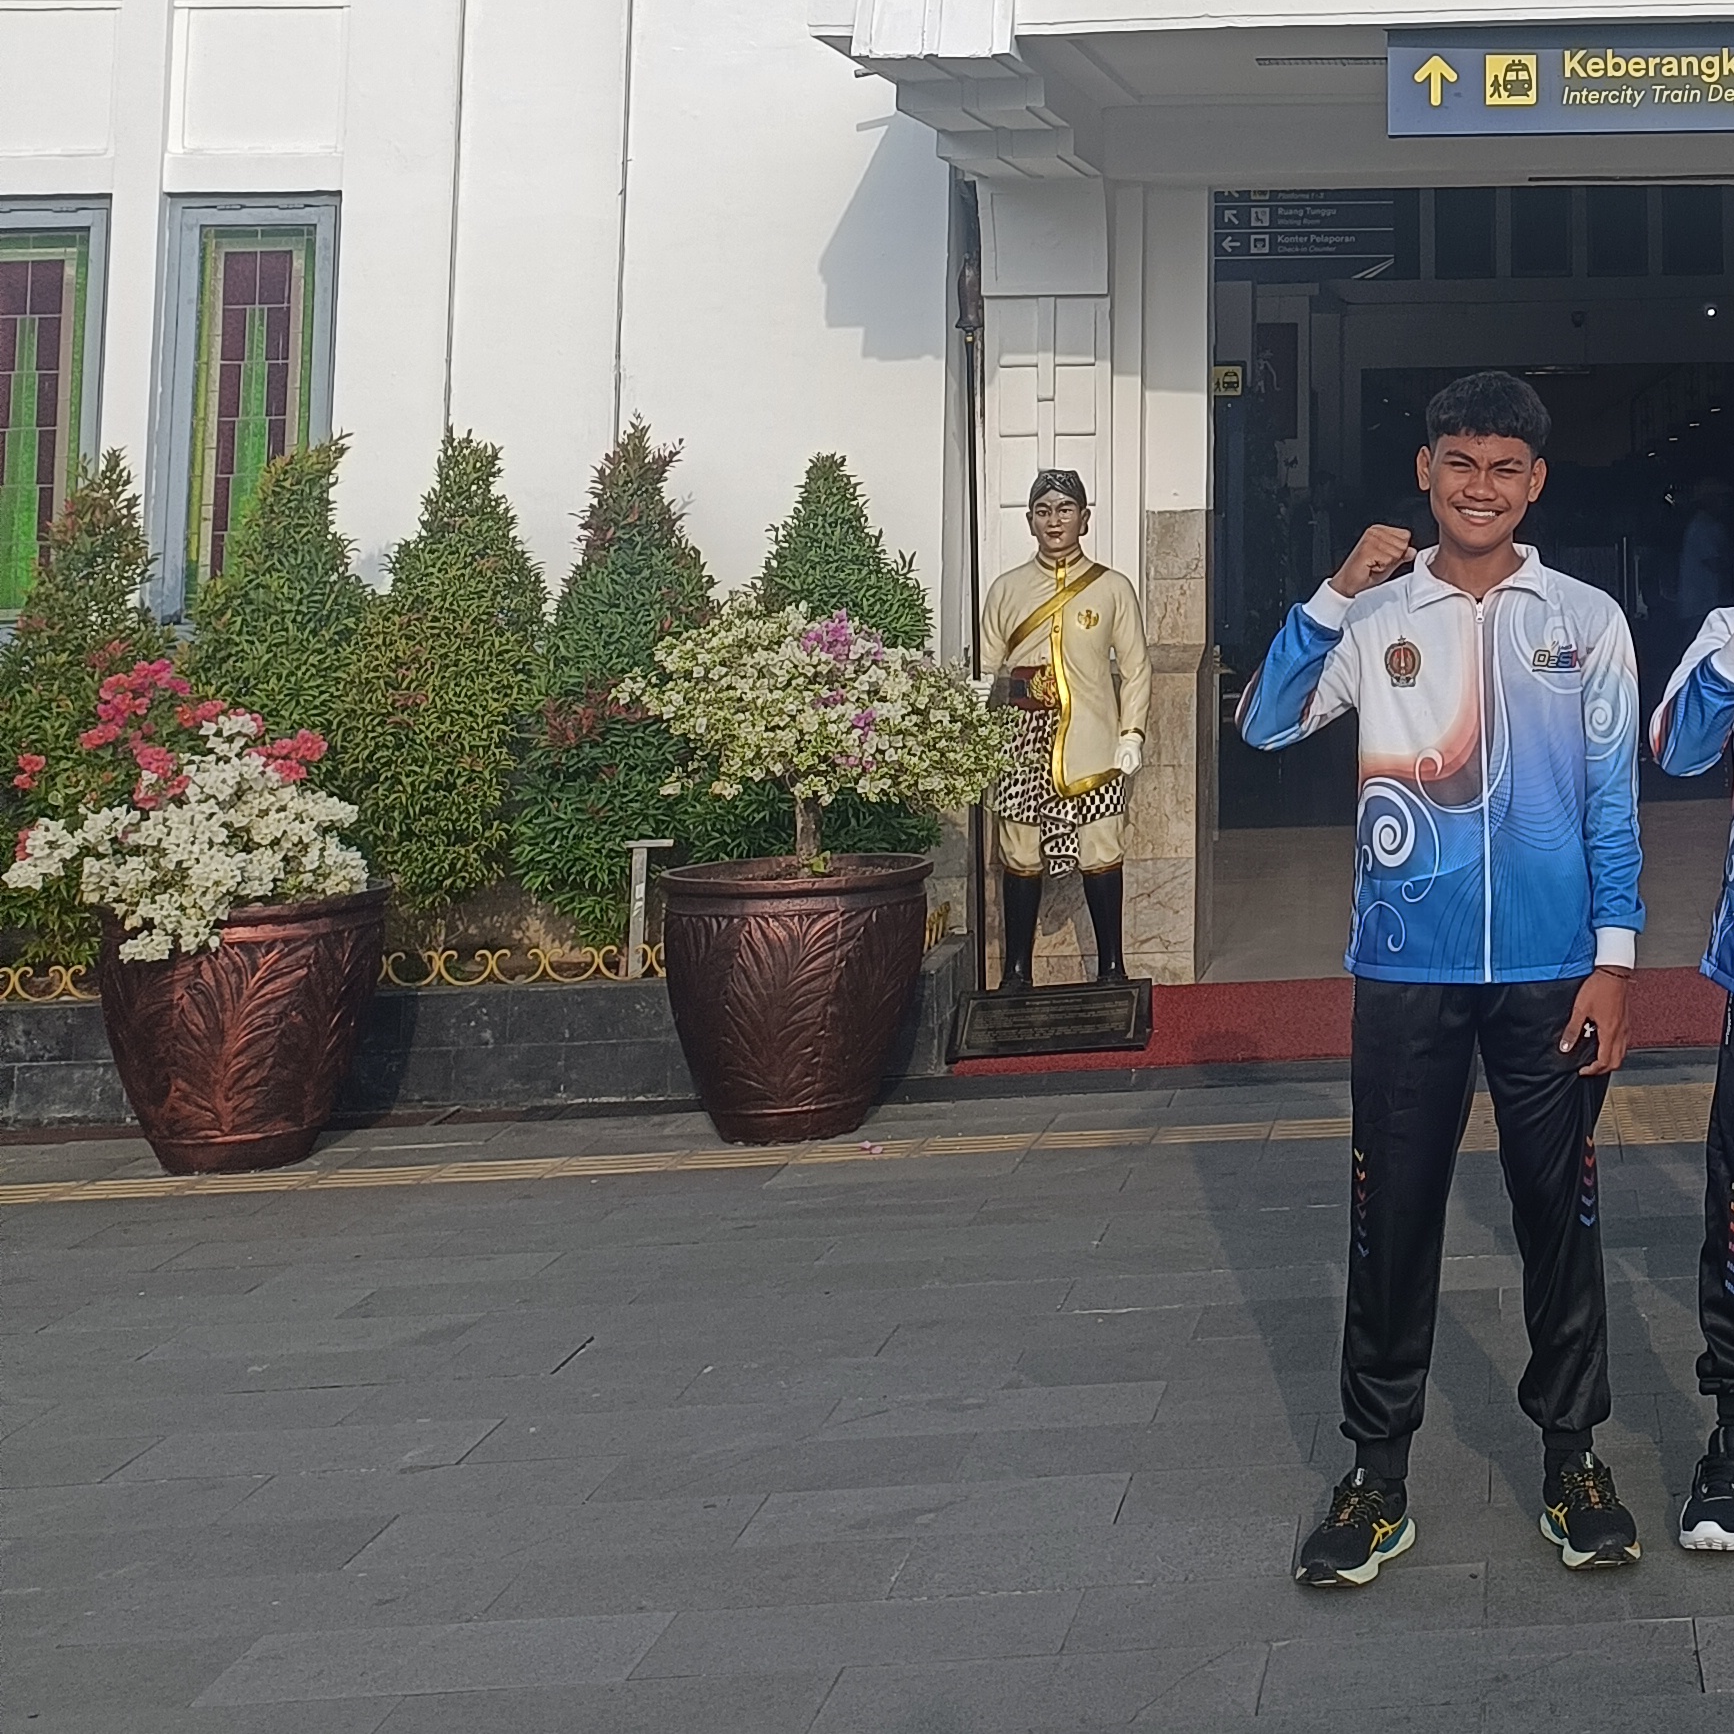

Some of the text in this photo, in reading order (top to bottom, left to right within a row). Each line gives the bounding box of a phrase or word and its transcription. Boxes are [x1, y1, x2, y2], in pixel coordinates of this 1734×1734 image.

[1562, 85, 1645, 107] Intercity
[1650, 84, 1702, 104] Train
[1278, 206, 1337, 217] Ruang Tunggu
[1277, 234, 1356, 245] Konter Pelaporan
[1277, 245, 1337, 253] Check-in Counter
